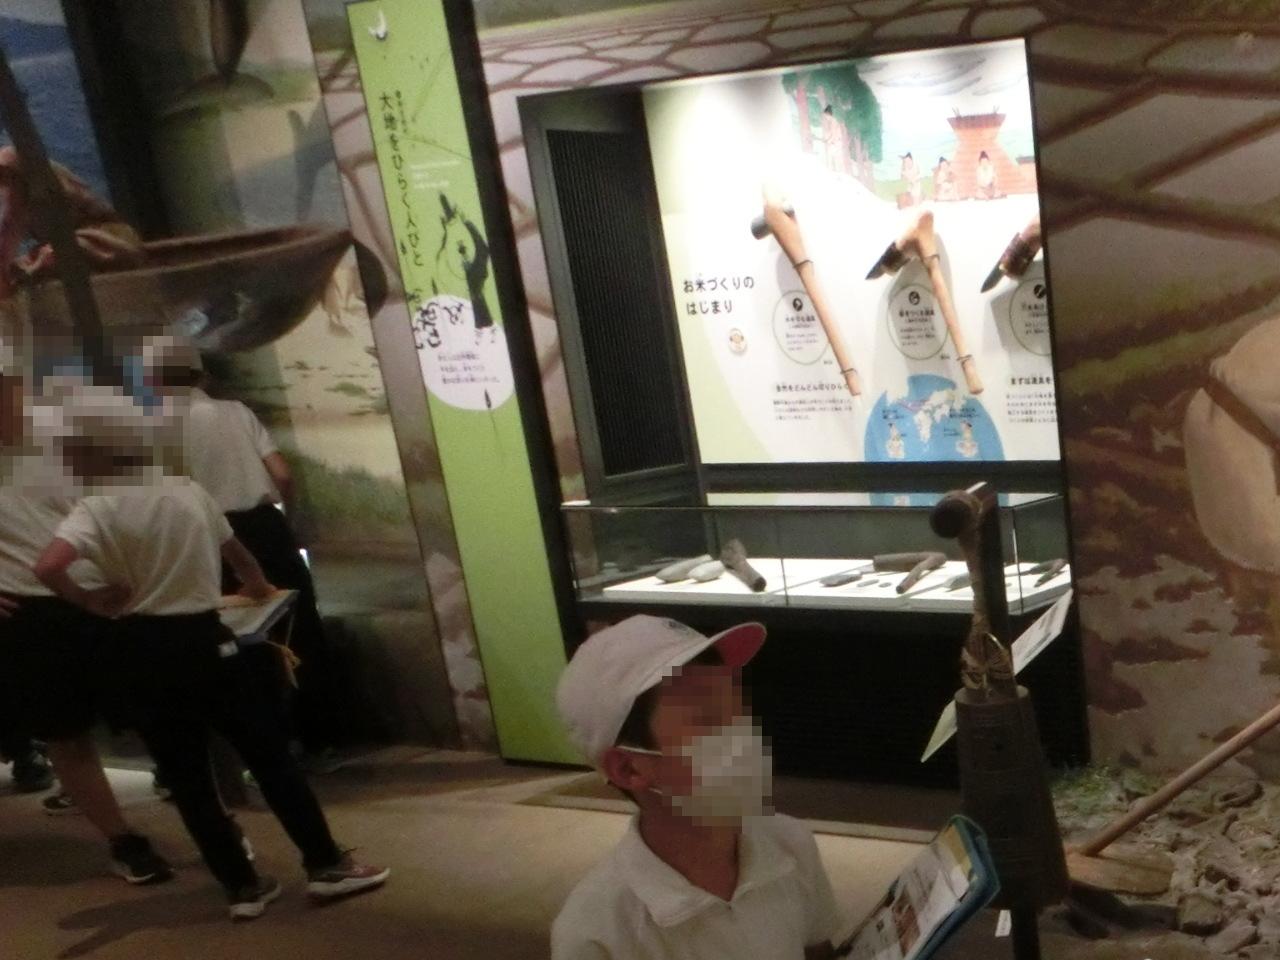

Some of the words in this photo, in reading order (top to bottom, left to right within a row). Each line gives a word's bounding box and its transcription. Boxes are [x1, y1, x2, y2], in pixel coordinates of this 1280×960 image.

[683, 275, 755, 293] お米づくりの
[686, 300, 733, 316] はじまり
